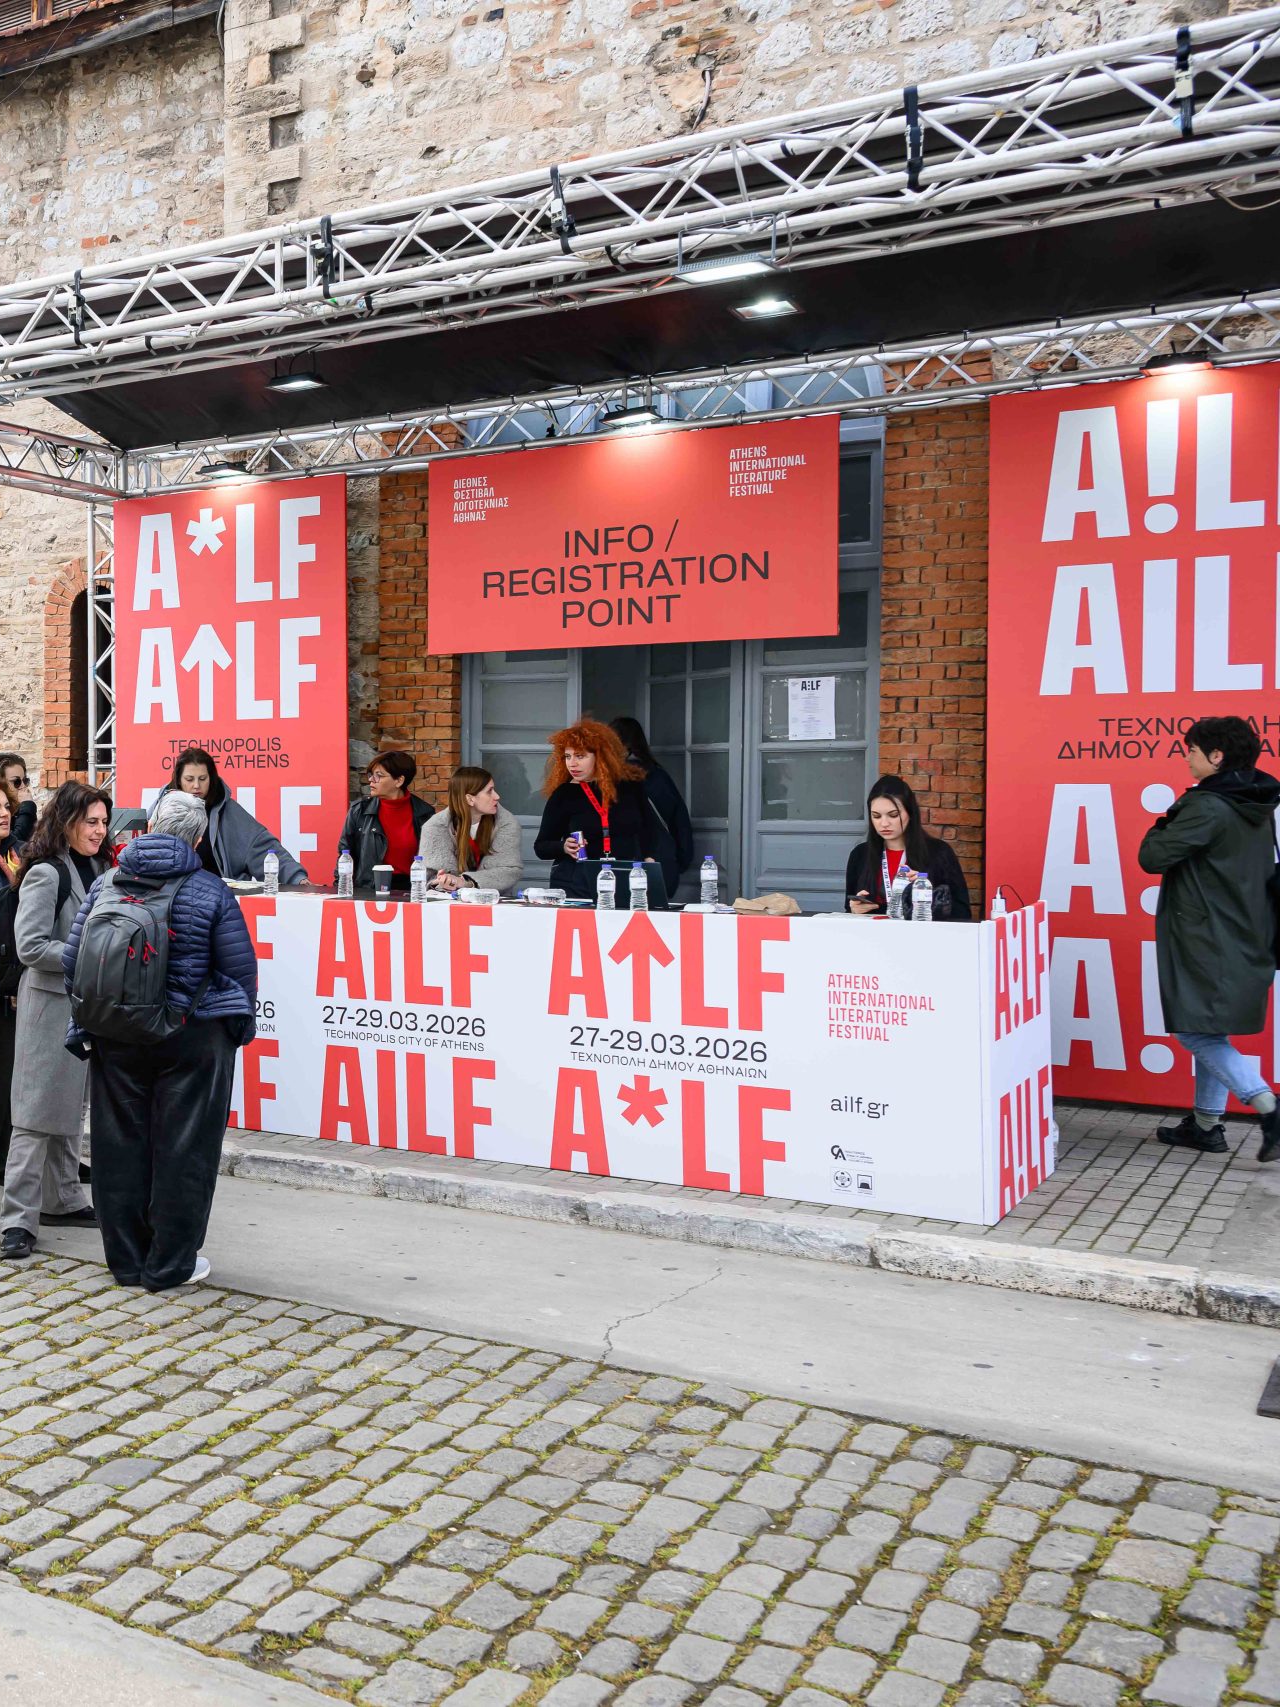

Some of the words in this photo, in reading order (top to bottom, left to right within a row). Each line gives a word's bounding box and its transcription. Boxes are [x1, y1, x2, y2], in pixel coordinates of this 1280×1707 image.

[729, 445, 767, 459] ATHENS
[729, 454, 807, 472] INTERNATIONAL
[453, 476, 488, 489] ΔΙΕΘΝΕΣ
[729, 469, 787, 485] LITERATURE
[453, 486, 495, 500] ΦΕΣΤΙΒΑΛ
[729, 483, 773, 498] FESTIVAL
[453, 497, 509, 511] ΛΟΓΟΤΕΧΝΙΑΣ
[453, 510, 486, 523] ΑΘΗΝΑΣ
[564, 524, 654, 558] INFO
[665, 519, 679, 553] /
[483, 550, 769, 599] REGISTRATION
[562, 594, 681, 629] POINT
[169, 737, 281, 753] TECHNOPOLIS
[1057, 740, 1161, 759] ΔΗΜΟΥ
[224, 754, 290, 769] ATHENS
[828, 973, 879, 990] ATHENS
[828, 990, 935, 1011] INTERNATIONAL
[322, 1005, 486, 1037] 27-29.03.2026
[828, 1007, 908, 1026] LITERATURE
[324, 1028, 395, 1044] TECHNOPOLIS
[398, 1035, 422, 1046] CITY
[424, 1038, 438, 1047] OF
[440, 1039, 484, 1052] ATHENS
[828, 1023, 890, 1042] FESTIVAL
[570, 1025, 767, 1063] 27-29.03.2026
[570, 1051, 646, 1068] ΤΕΧΝΟΠΟΛΗ
[649, 1058, 694, 1072] ΔΗΜΟΥ
[697, 1063, 767, 1079] ΑΘΗΝΑΙΩΝ
[320, 1044, 495, 1159] AILF
[830, 1096, 889, 1119] ailf.gr
